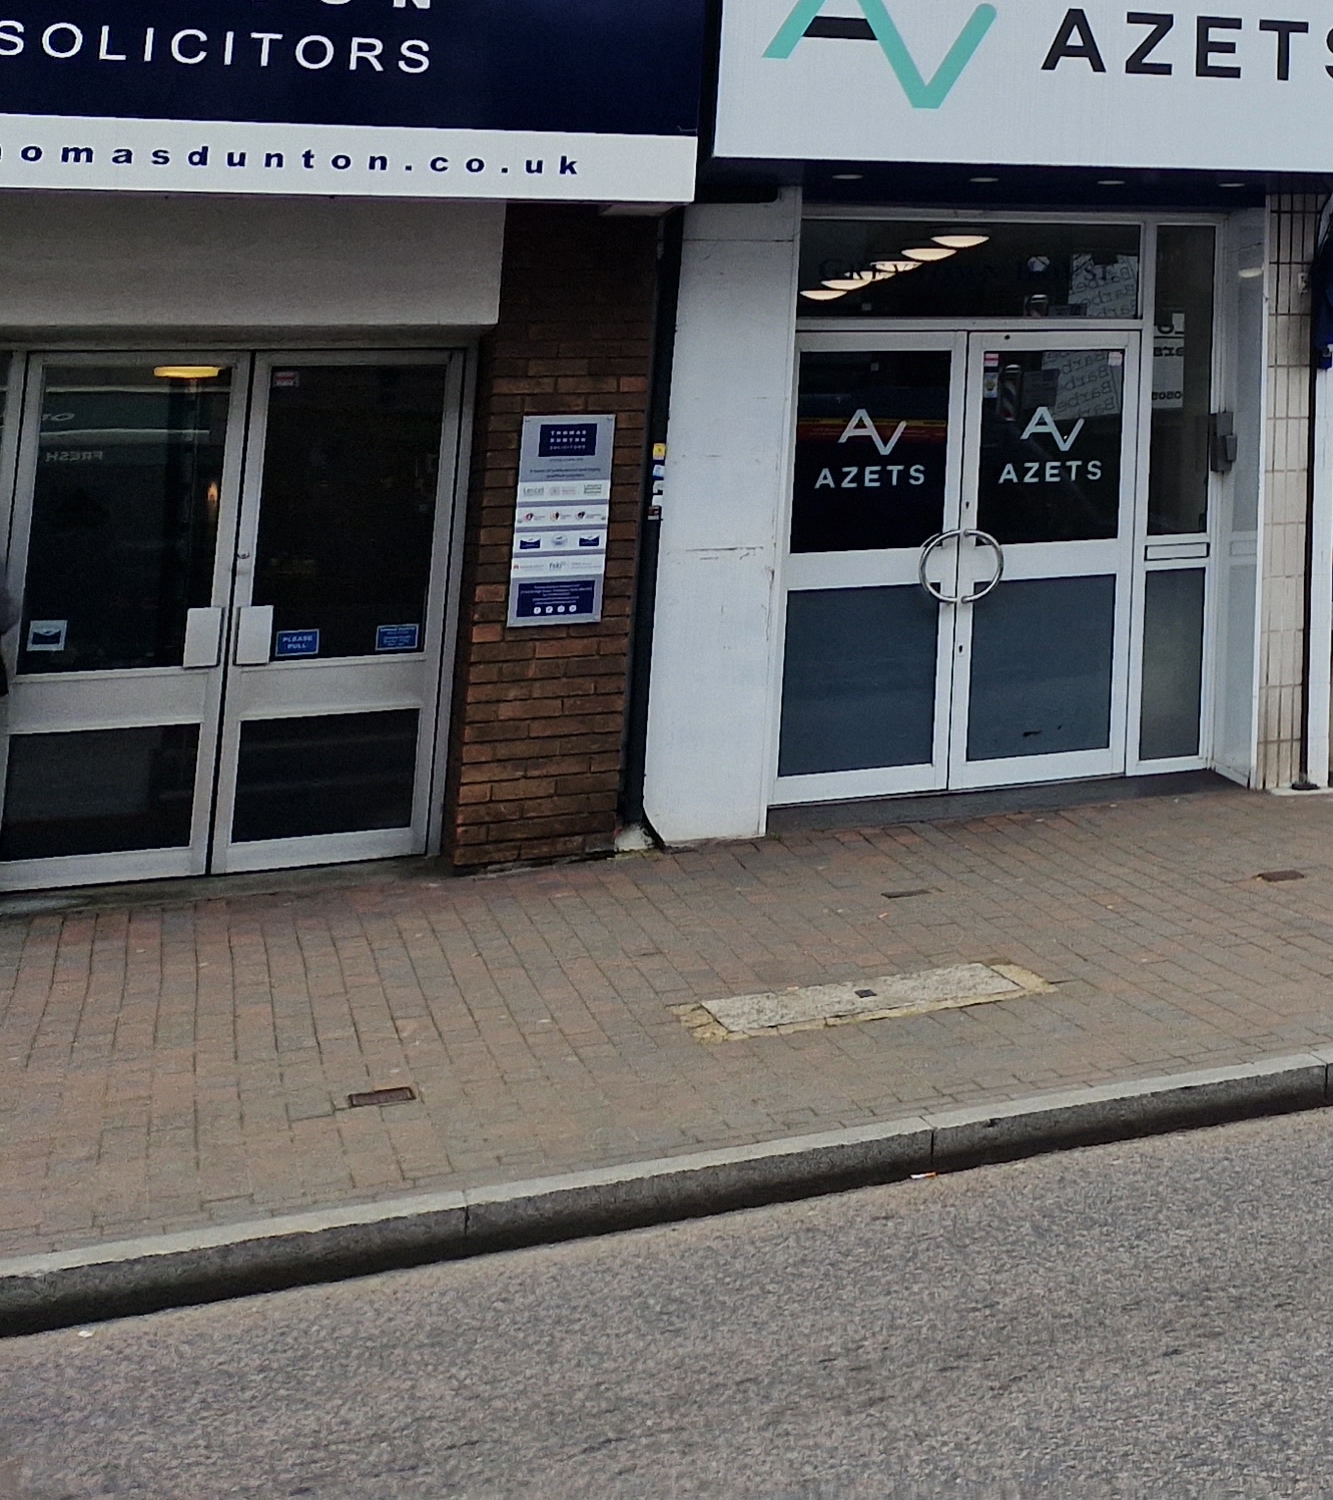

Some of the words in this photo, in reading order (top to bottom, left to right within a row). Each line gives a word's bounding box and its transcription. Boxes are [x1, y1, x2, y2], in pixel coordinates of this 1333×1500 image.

[0, 19, 431, 75] SOLICITORS
[0, 143, 579, 178] omasdunton.co.uk
[814, 463, 926, 490] AZETS
[998, 458, 1102, 485] AZETS
[282, 635, 313, 643] PLEASE
